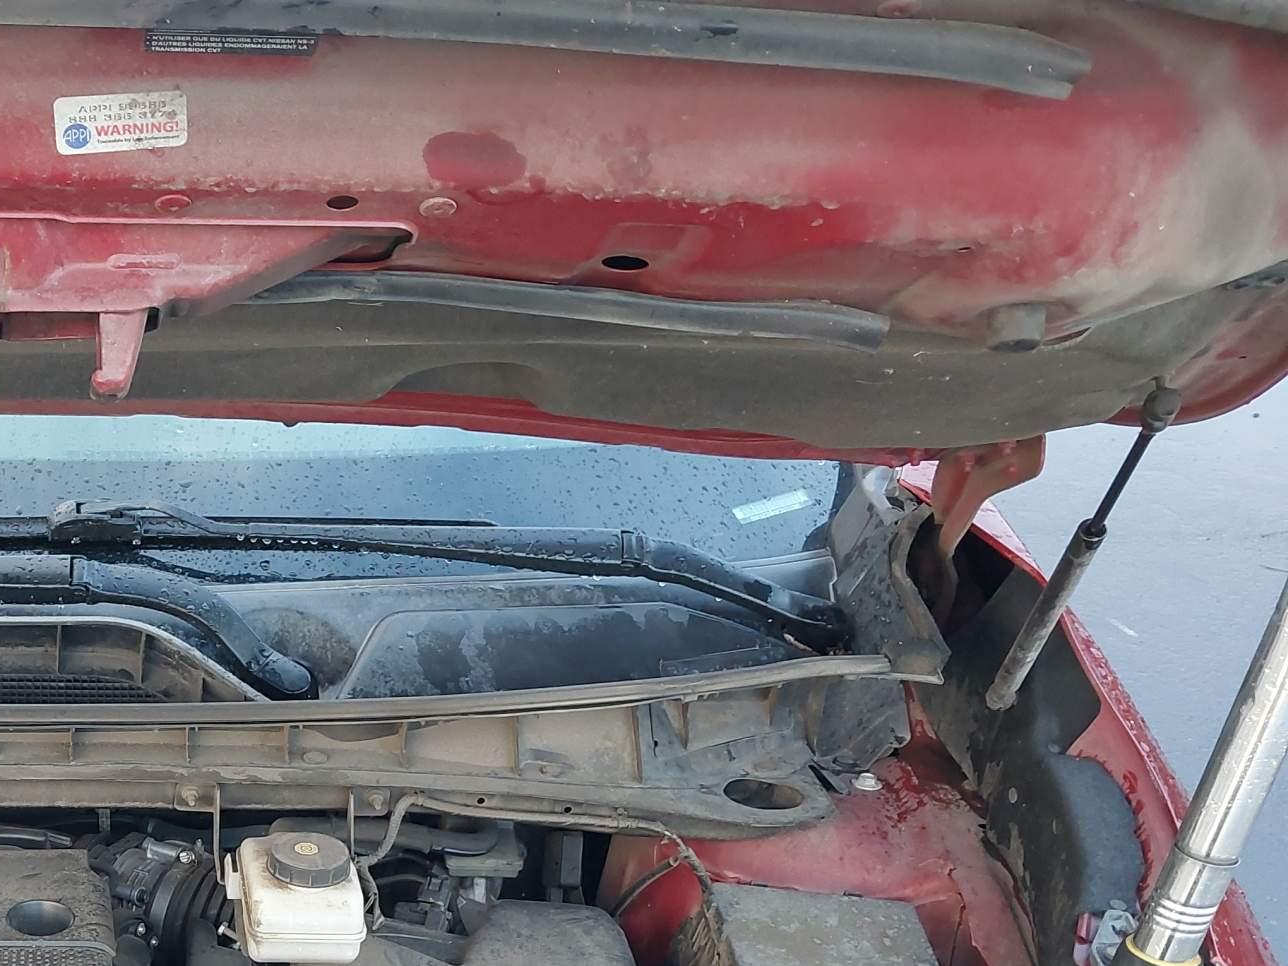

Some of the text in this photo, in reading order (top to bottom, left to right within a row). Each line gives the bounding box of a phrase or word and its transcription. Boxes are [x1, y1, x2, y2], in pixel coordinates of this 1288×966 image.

[78, 104, 112, 114] APPI
[63, 127, 90, 143] APPI
[95, 121, 179, 137] WARNING!
